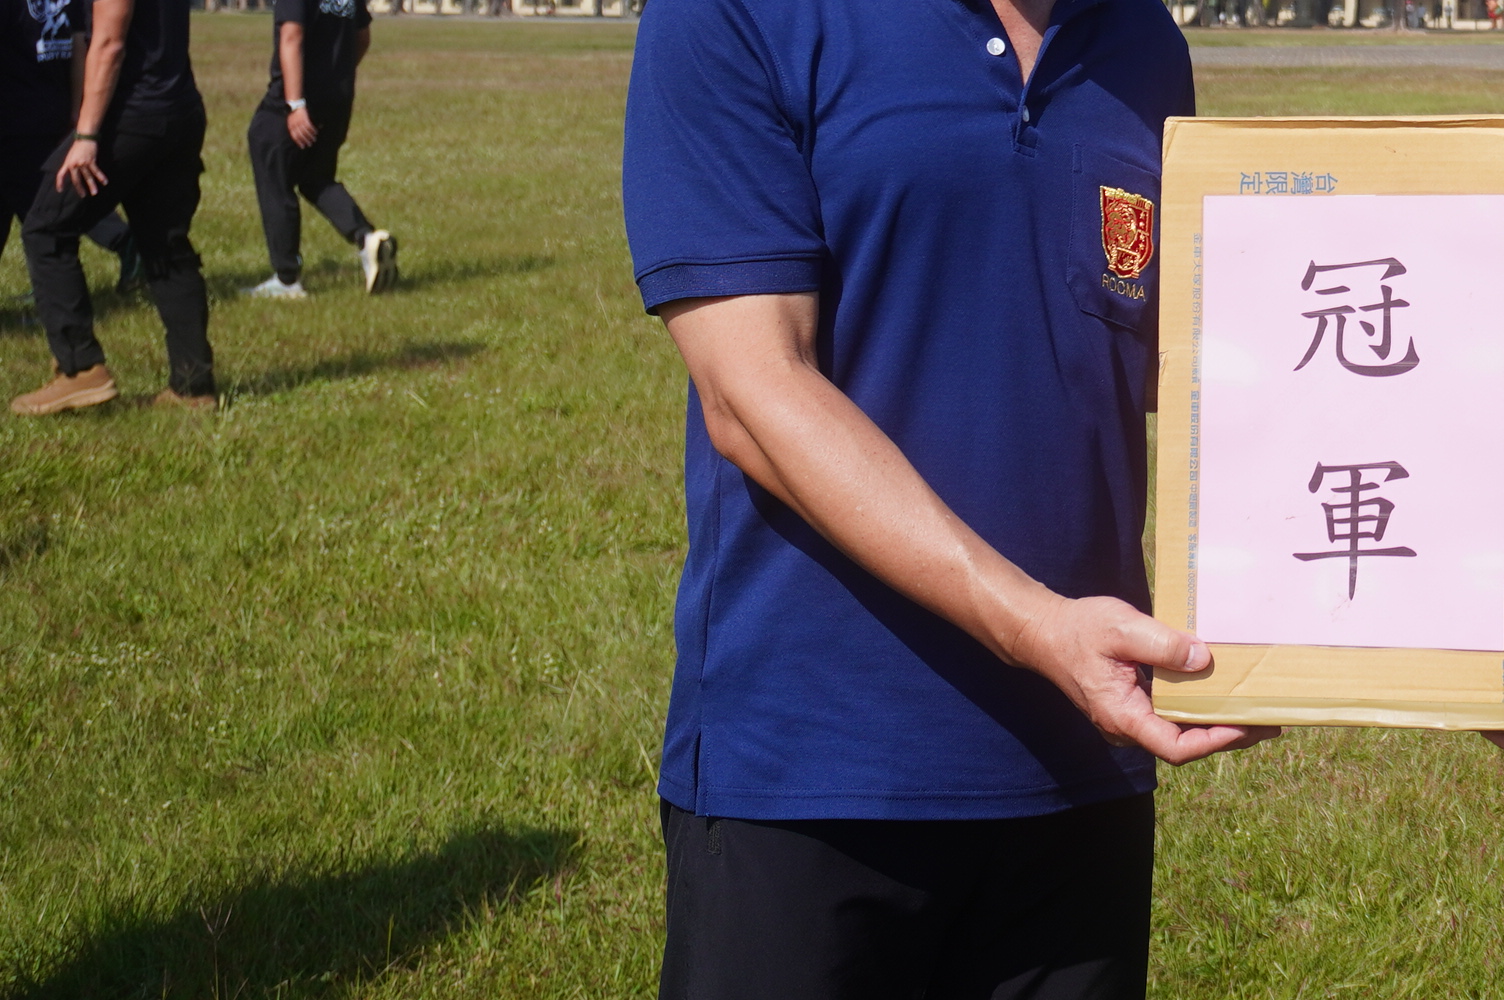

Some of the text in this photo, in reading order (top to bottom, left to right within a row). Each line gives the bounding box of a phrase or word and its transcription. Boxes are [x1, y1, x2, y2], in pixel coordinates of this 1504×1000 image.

[1239, 171, 1339, 195] 台灣限定
[1101, 273, 1147, 302] ROCMA
[1292, 256, 1421, 601] 冠軍
